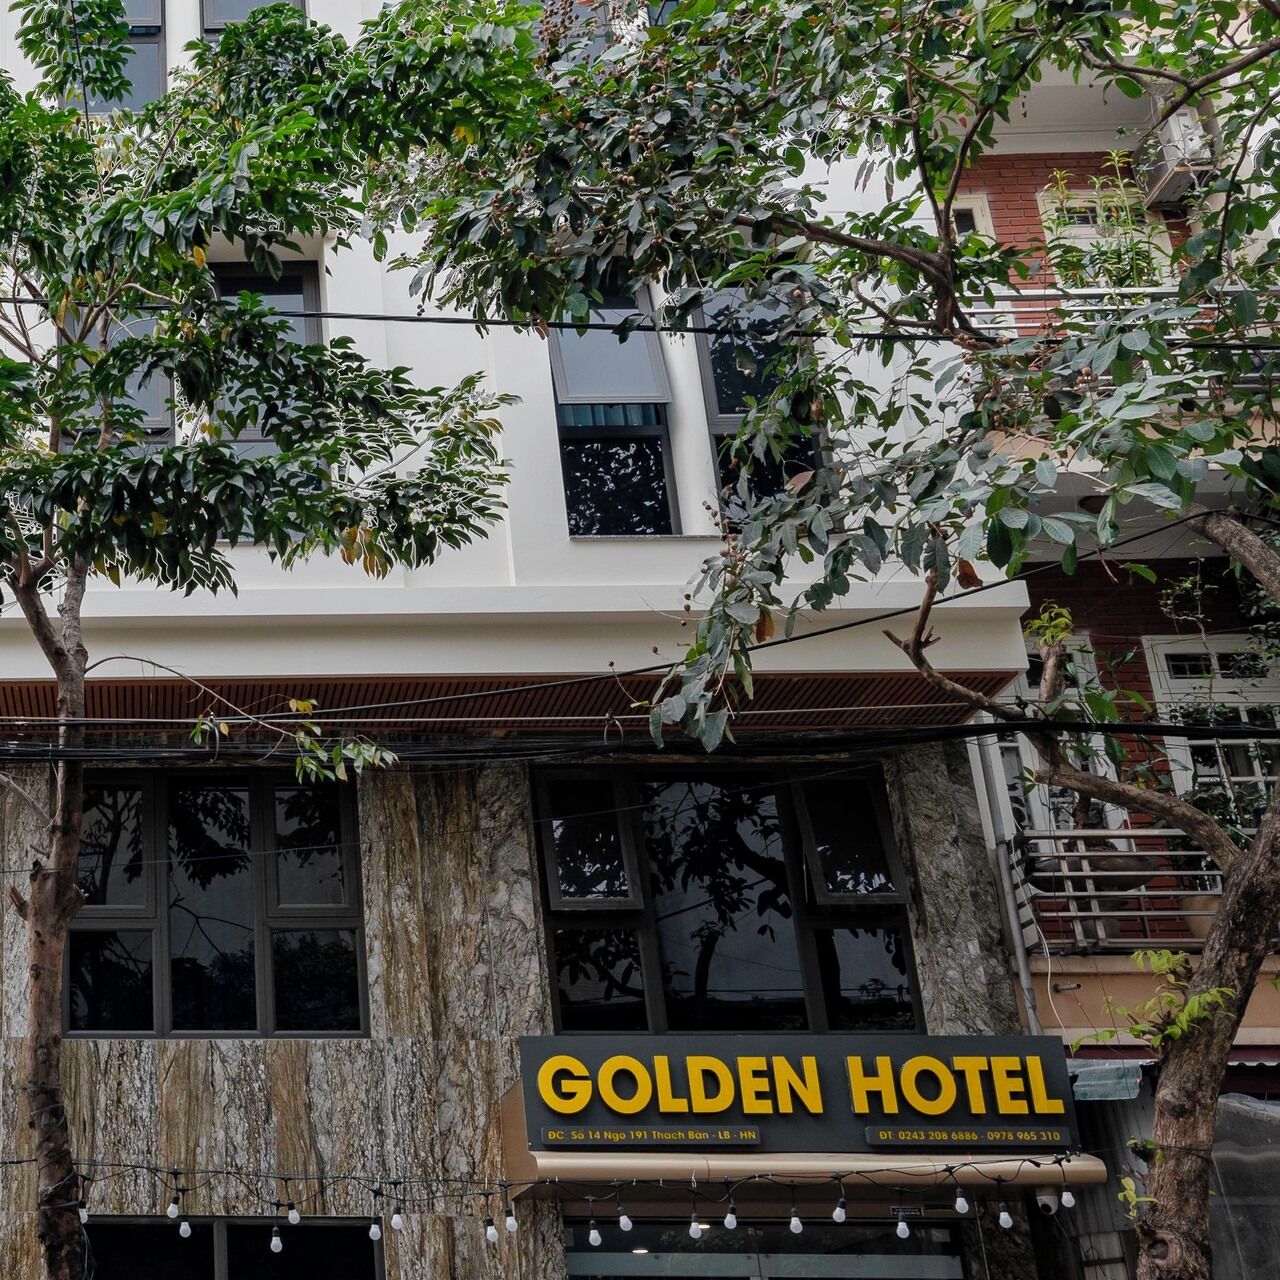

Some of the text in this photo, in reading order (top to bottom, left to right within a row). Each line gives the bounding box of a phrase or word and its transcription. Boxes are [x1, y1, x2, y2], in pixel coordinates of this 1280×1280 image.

[537, 1055, 1065, 1116] GOLDEN HOTEL
[588, 1130, 601, 1140] 14
[630, 1130, 648, 1140] 191
[718, 1130, 731, 1140] LB
[740, 1130, 757, 1140] HN
[899, 1130, 926, 1141] 0243
[928, 1130, 949, 1141] 208
[1017, 1131, 1037, 1141] 965
[1040, 1131, 1060, 1141] 310
